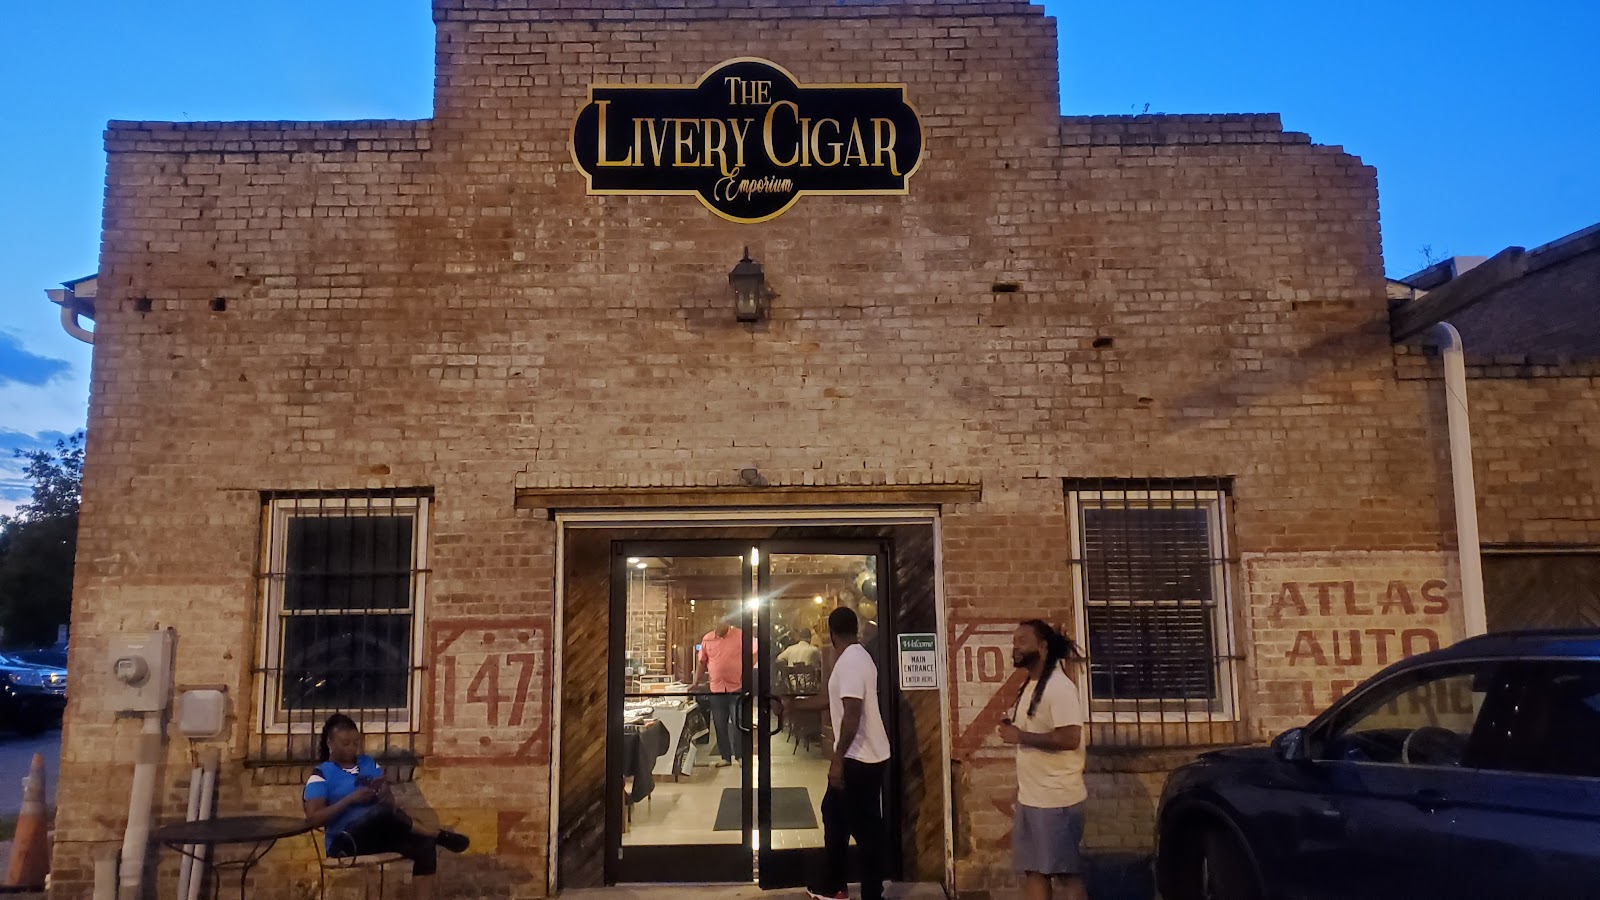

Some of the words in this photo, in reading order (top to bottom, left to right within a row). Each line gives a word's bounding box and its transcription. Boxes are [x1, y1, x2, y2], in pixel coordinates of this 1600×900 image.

[724, 76, 772, 106] THE
[594, 100, 755, 176] LIVERY
[763, 100, 902, 176] CIGAR
[713, 166, 794, 201] Emporium
[1268, 579, 1450, 622] ATLAS
[902, 639, 934, 649] Welcome
[911, 655, 926, 663] MAIN
[1285, 628, 1440, 667] AUTO
[903, 664, 934, 673] ENTRANCE
[443, 653, 536, 727] 147
